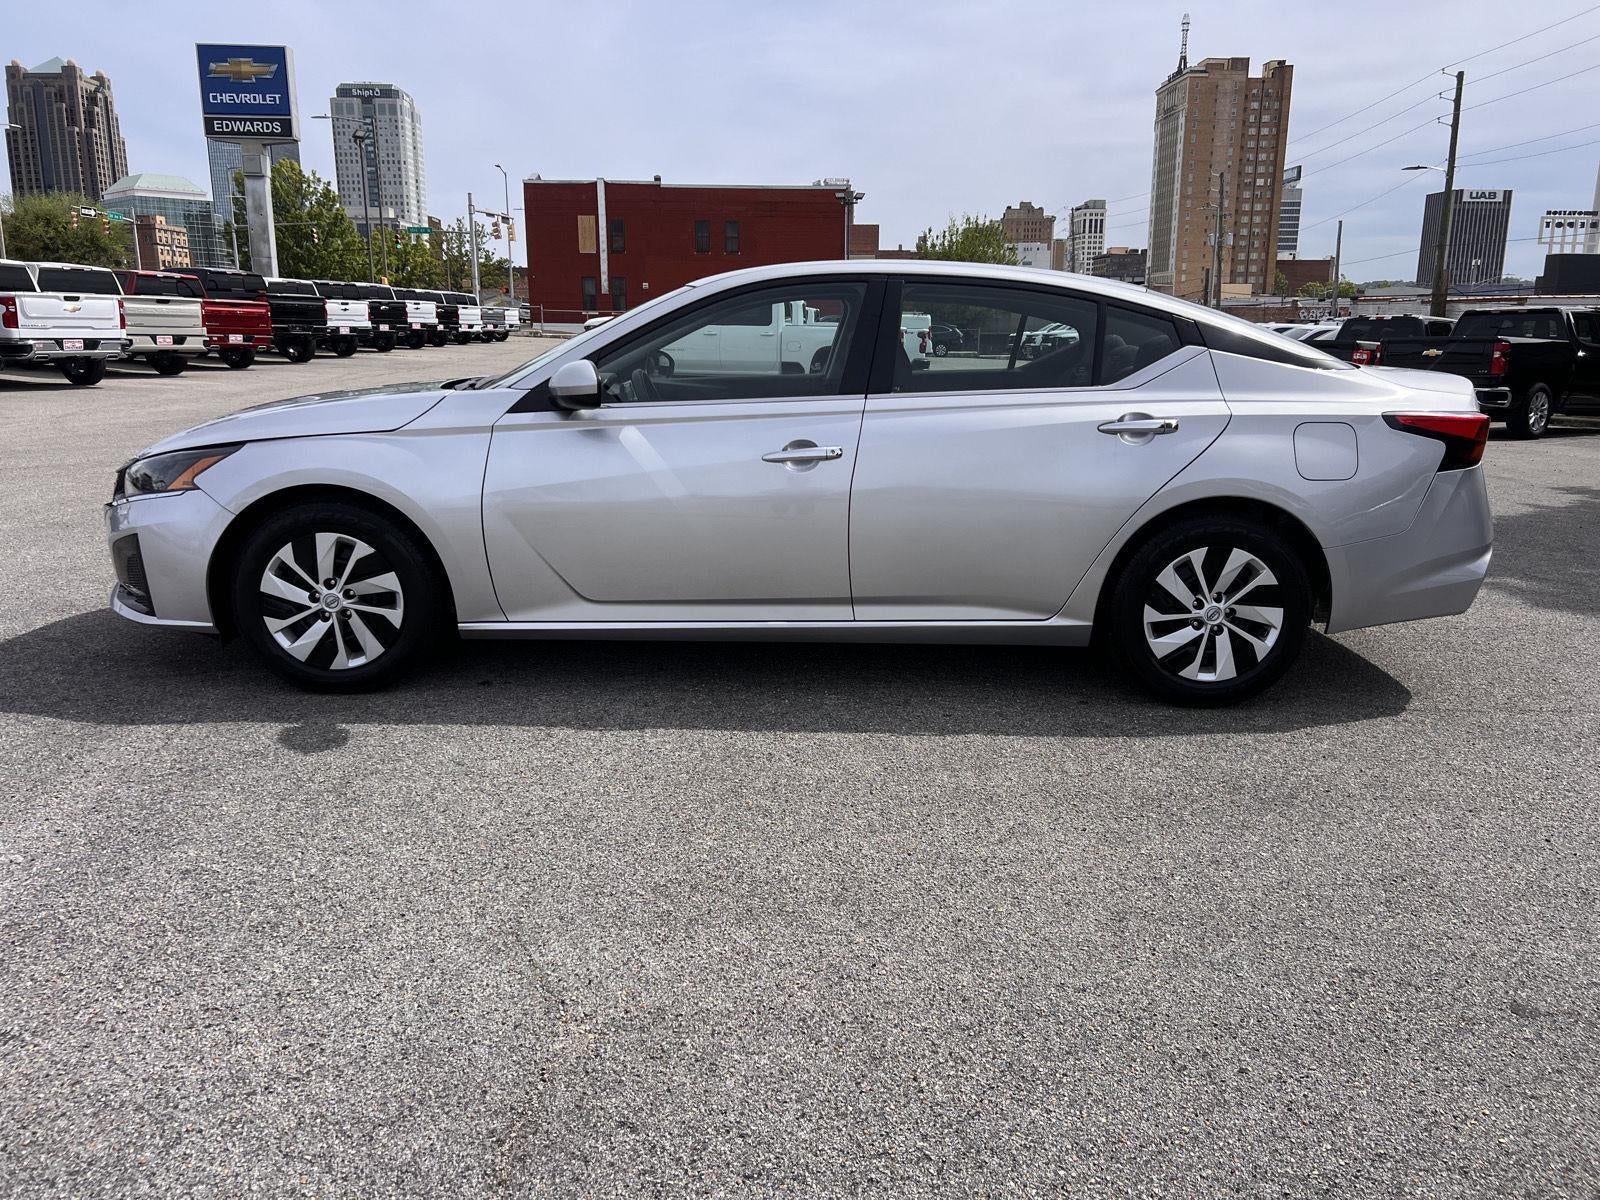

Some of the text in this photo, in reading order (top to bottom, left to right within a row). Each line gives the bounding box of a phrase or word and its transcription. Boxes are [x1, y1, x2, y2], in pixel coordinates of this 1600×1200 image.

[351, 88, 373, 97] Shipt
[209, 92, 281, 105] CHEVROLET
[213, 120, 281, 133] EDWARDS
[1469, 191, 1497, 200] UAB
